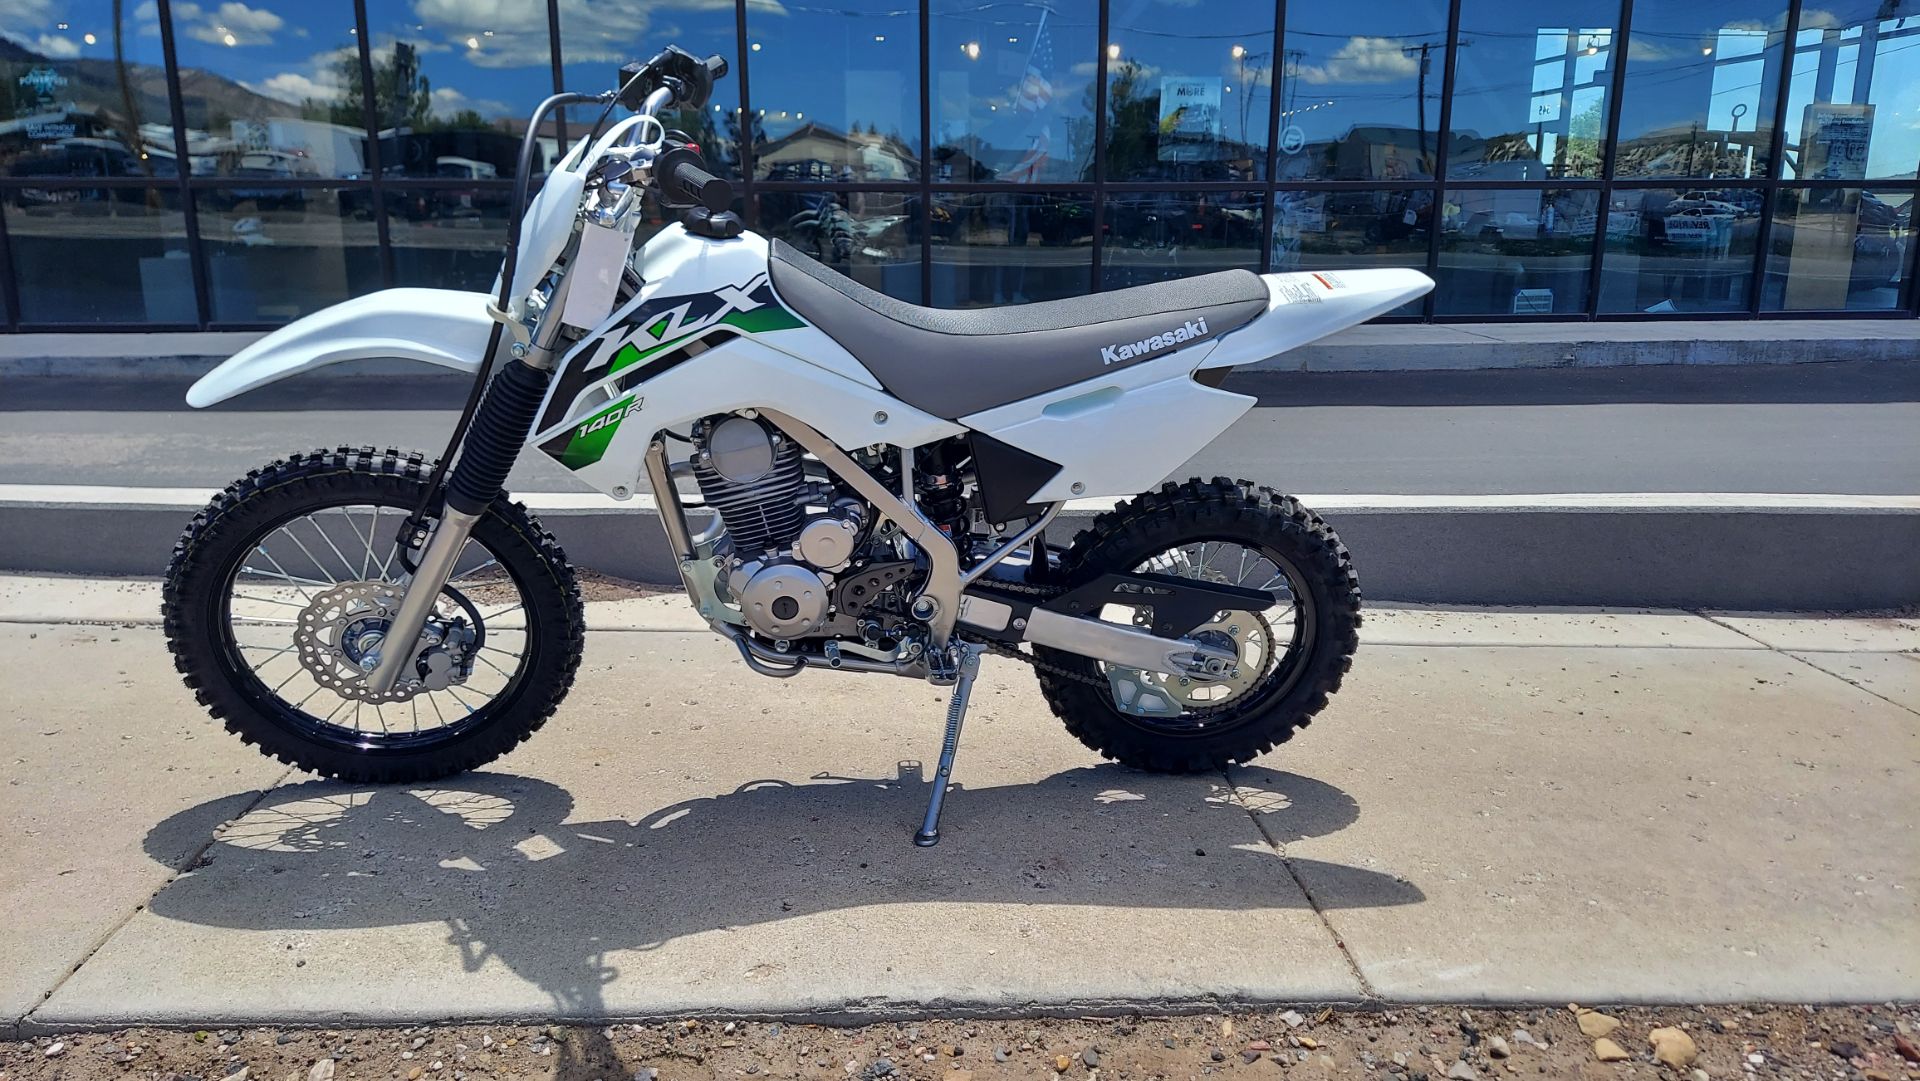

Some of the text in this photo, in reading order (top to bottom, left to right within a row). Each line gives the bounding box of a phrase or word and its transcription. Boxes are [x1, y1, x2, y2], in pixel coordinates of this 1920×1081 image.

[1177, 87, 1206, 97] MORE
[583, 271, 768, 372] KLX
[1100, 316, 1209, 365] Kawasaki
[578, 397, 645, 439] 140R
